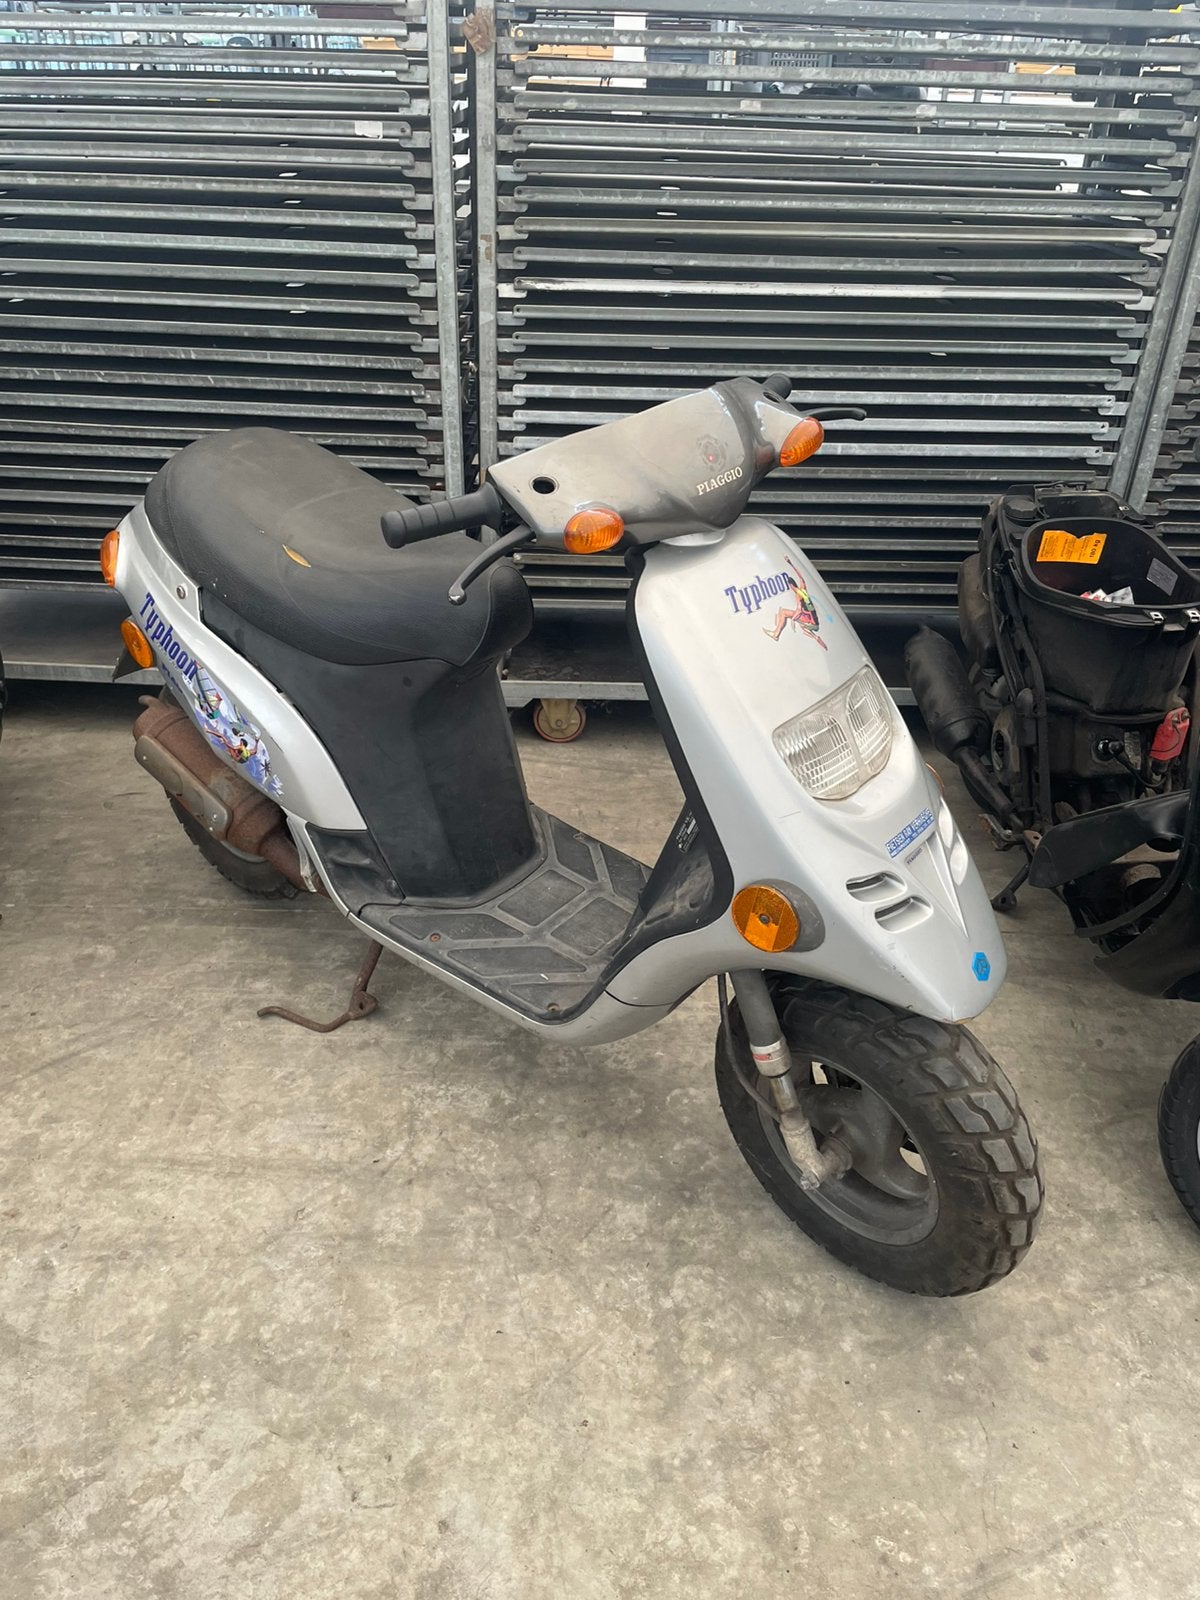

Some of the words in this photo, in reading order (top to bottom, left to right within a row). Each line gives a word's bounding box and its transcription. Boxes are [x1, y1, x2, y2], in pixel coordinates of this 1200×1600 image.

[696, 466, 743, 496] PIAGGIO
[724, 572, 790, 614] Typhoon
[140, 592, 198, 681] Typhoon
